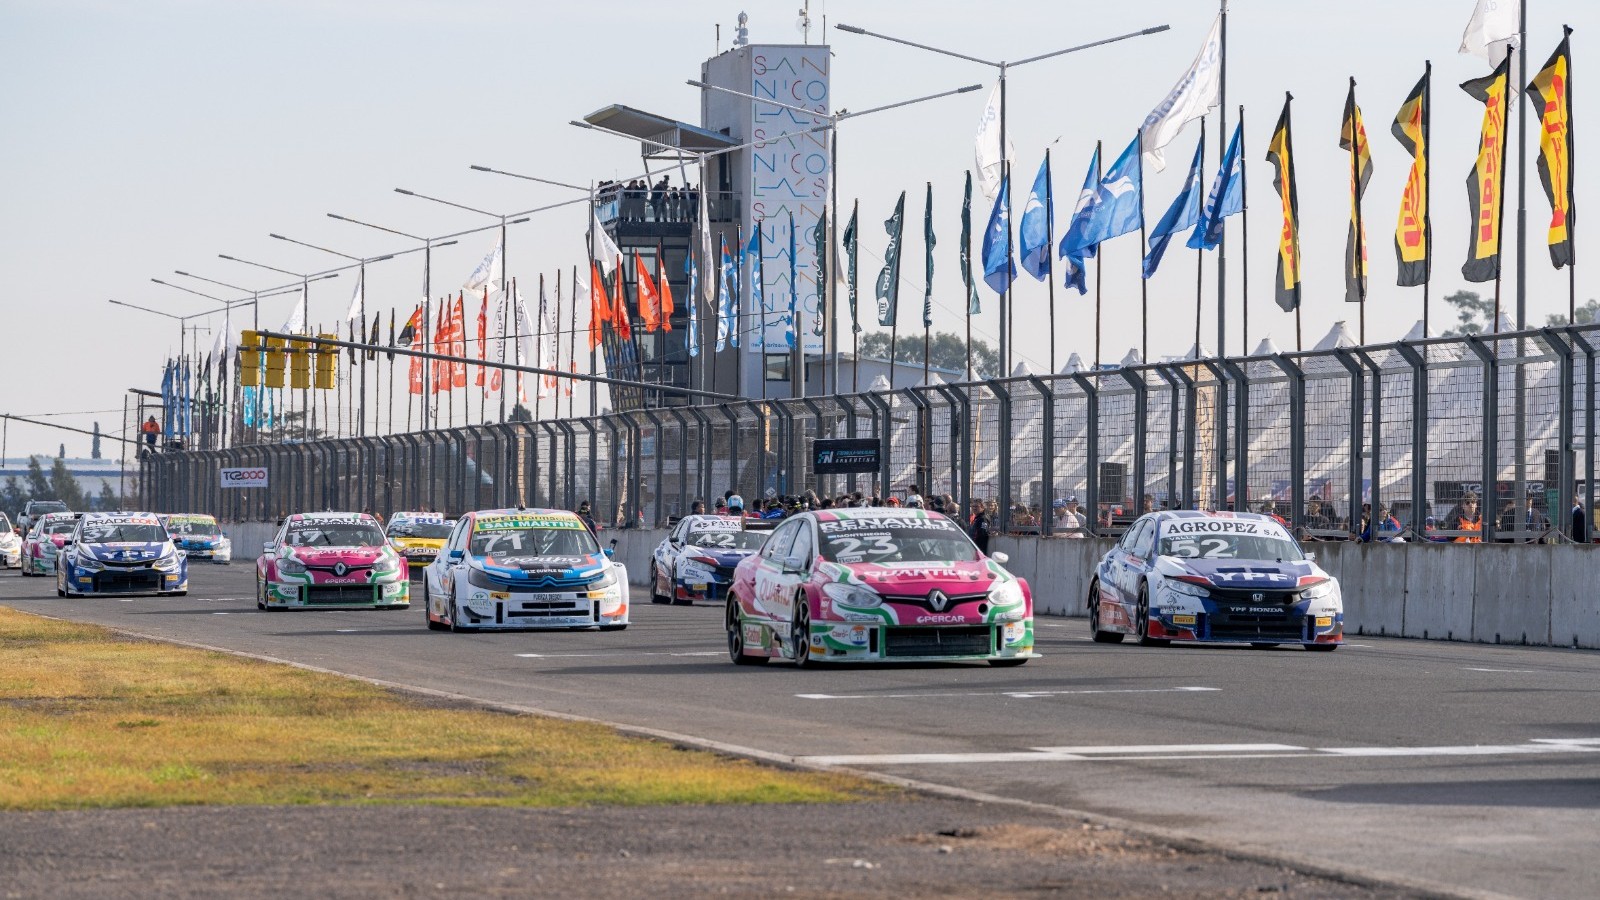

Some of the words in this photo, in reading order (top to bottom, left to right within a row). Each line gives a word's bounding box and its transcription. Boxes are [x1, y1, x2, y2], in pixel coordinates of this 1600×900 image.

[753, 55, 827, 76] SAN
[222, 470, 266, 481] TC2000
[819, 517, 952, 532] RENAULT
[1167, 521, 1258, 534] AGROPEZ
[1263, 528, 1283, 538] S.A.
[83, 526, 119, 540] 37
[288, 531, 322, 546] 17
[695, 533, 737, 547] 42
[476, 531, 526, 553] 71
[829, 536, 899, 557] 23
[1170, 538, 1233, 558] 52
[101, 550, 156, 559] YPF
[864, 568, 981, 578] QUANTIUM
[1217, 572, 1288, 581] YPF
